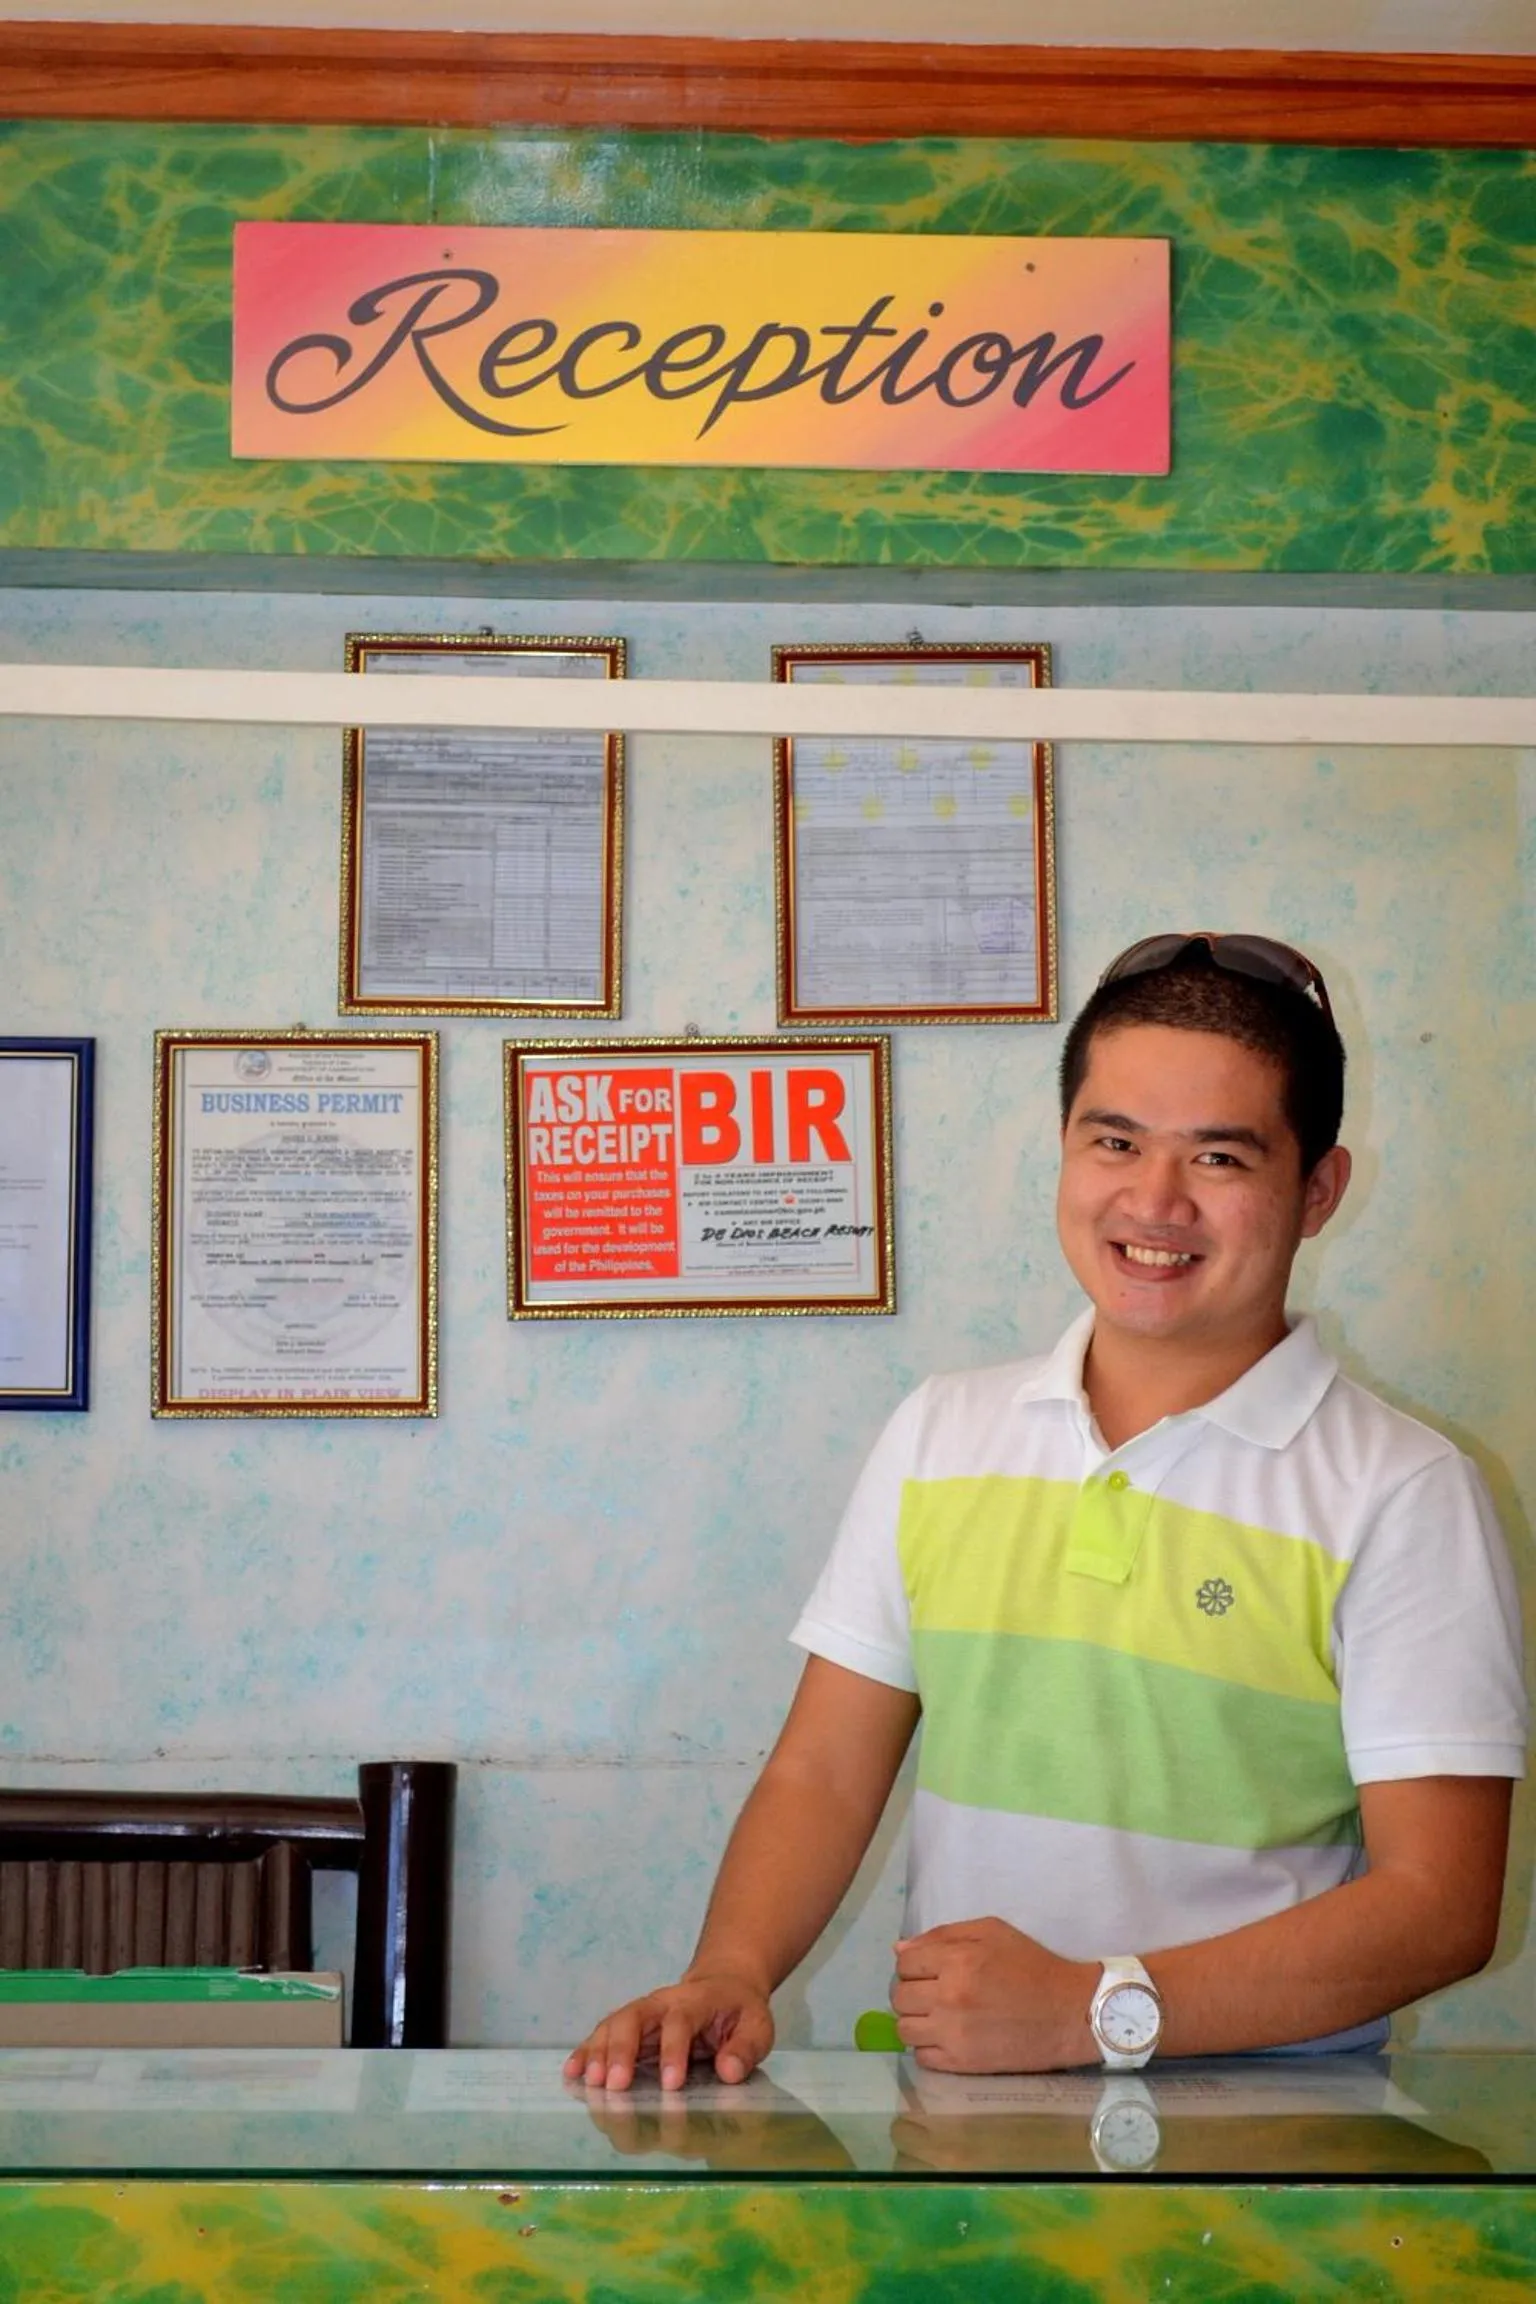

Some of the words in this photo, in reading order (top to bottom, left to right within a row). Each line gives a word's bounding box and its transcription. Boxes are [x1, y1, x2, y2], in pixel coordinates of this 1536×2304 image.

[265, 268, 1138, 442] Reception
[201, 1092, 310, 1114] BUSINESS
[316, 1092, 404, 1114] PERMIT
[528, 1074, 615, 1124] ASK
[618, 1087, 673, 1113] FOR
[679, 1068, 852, 1165] BIR
[528, 1123, 674, 1166] RECEIPT
[537, 1170, 561, 1183] This
[563, 1170, 582, 1183] will
[584, 1171, 624, 1183] ensure
[625, 1168, 648, 1181] that
[649, 1168, 669, 1181] the
[534, 1190, 564, 1201] taxes
[566, 1190, 582, 1201] on
[582, 1190, 609, 1203] your
[611, 1187, 671, 1202] purchases
[543, 1207, 563, 1218] will
[565, 1206, 579, 1218] be
[582, 1204, 628, 1217] remitted
[630, 1204, 642, 1217] to
[644, 1204, 663, 1217] the
[628, 1221, 648, 1235] will
[650, 1221, 665, 1234] be
[533, 1242, 561, 1255] used
[563, 1241, 579, 1254] for
[581, 1242, 600, 1254] the
[602, 1240, 676, 1257] development
[554, 1260, 567, 1273] of
[568, 1259, 586, 1273] the
[199, 1387, 271, 1400] DISPLAY
[277, 1387, 295, 1400] IN
[301, 1387, 352, 1399] PLAIN
[357, 1387, 403, 1399] VIEW
